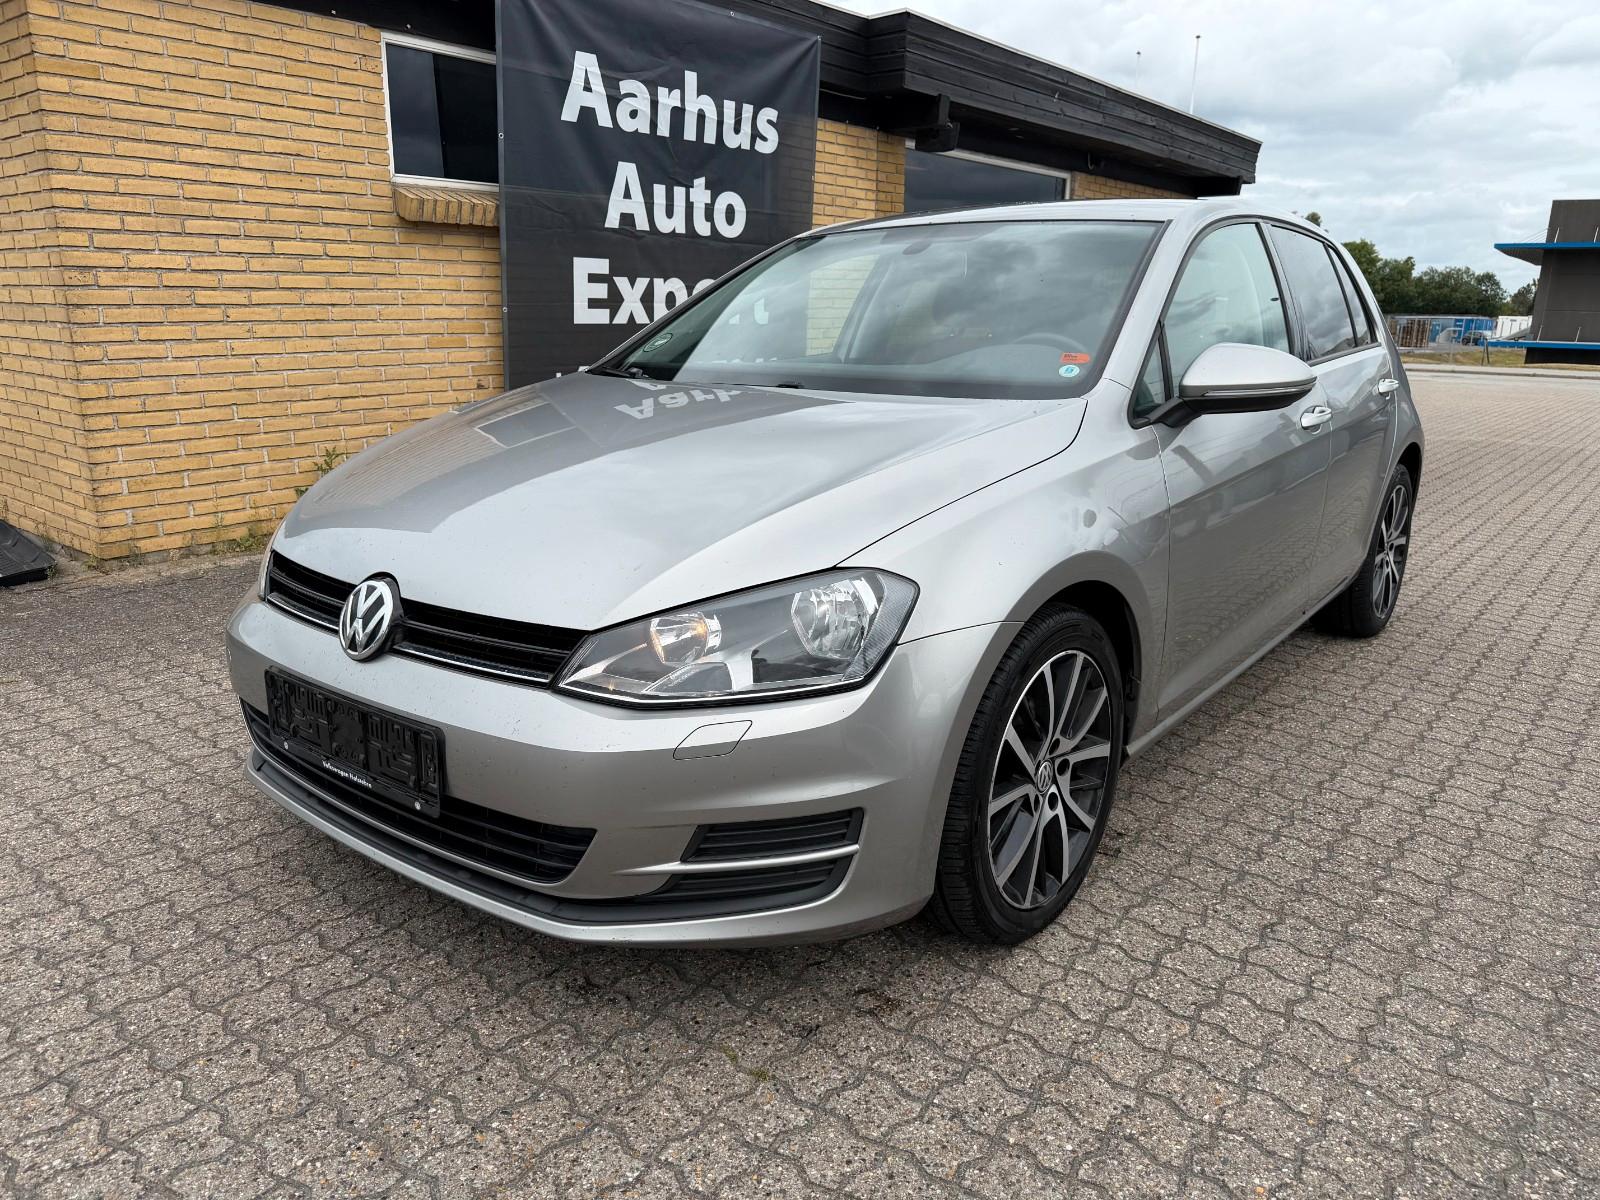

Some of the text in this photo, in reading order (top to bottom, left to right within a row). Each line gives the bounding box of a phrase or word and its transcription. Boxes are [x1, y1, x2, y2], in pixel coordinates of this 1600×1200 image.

[560, 50, 780, 154] Aarhus
[604, 160, 748, 239] Auto
[572, 256, 769, 325] Exp
